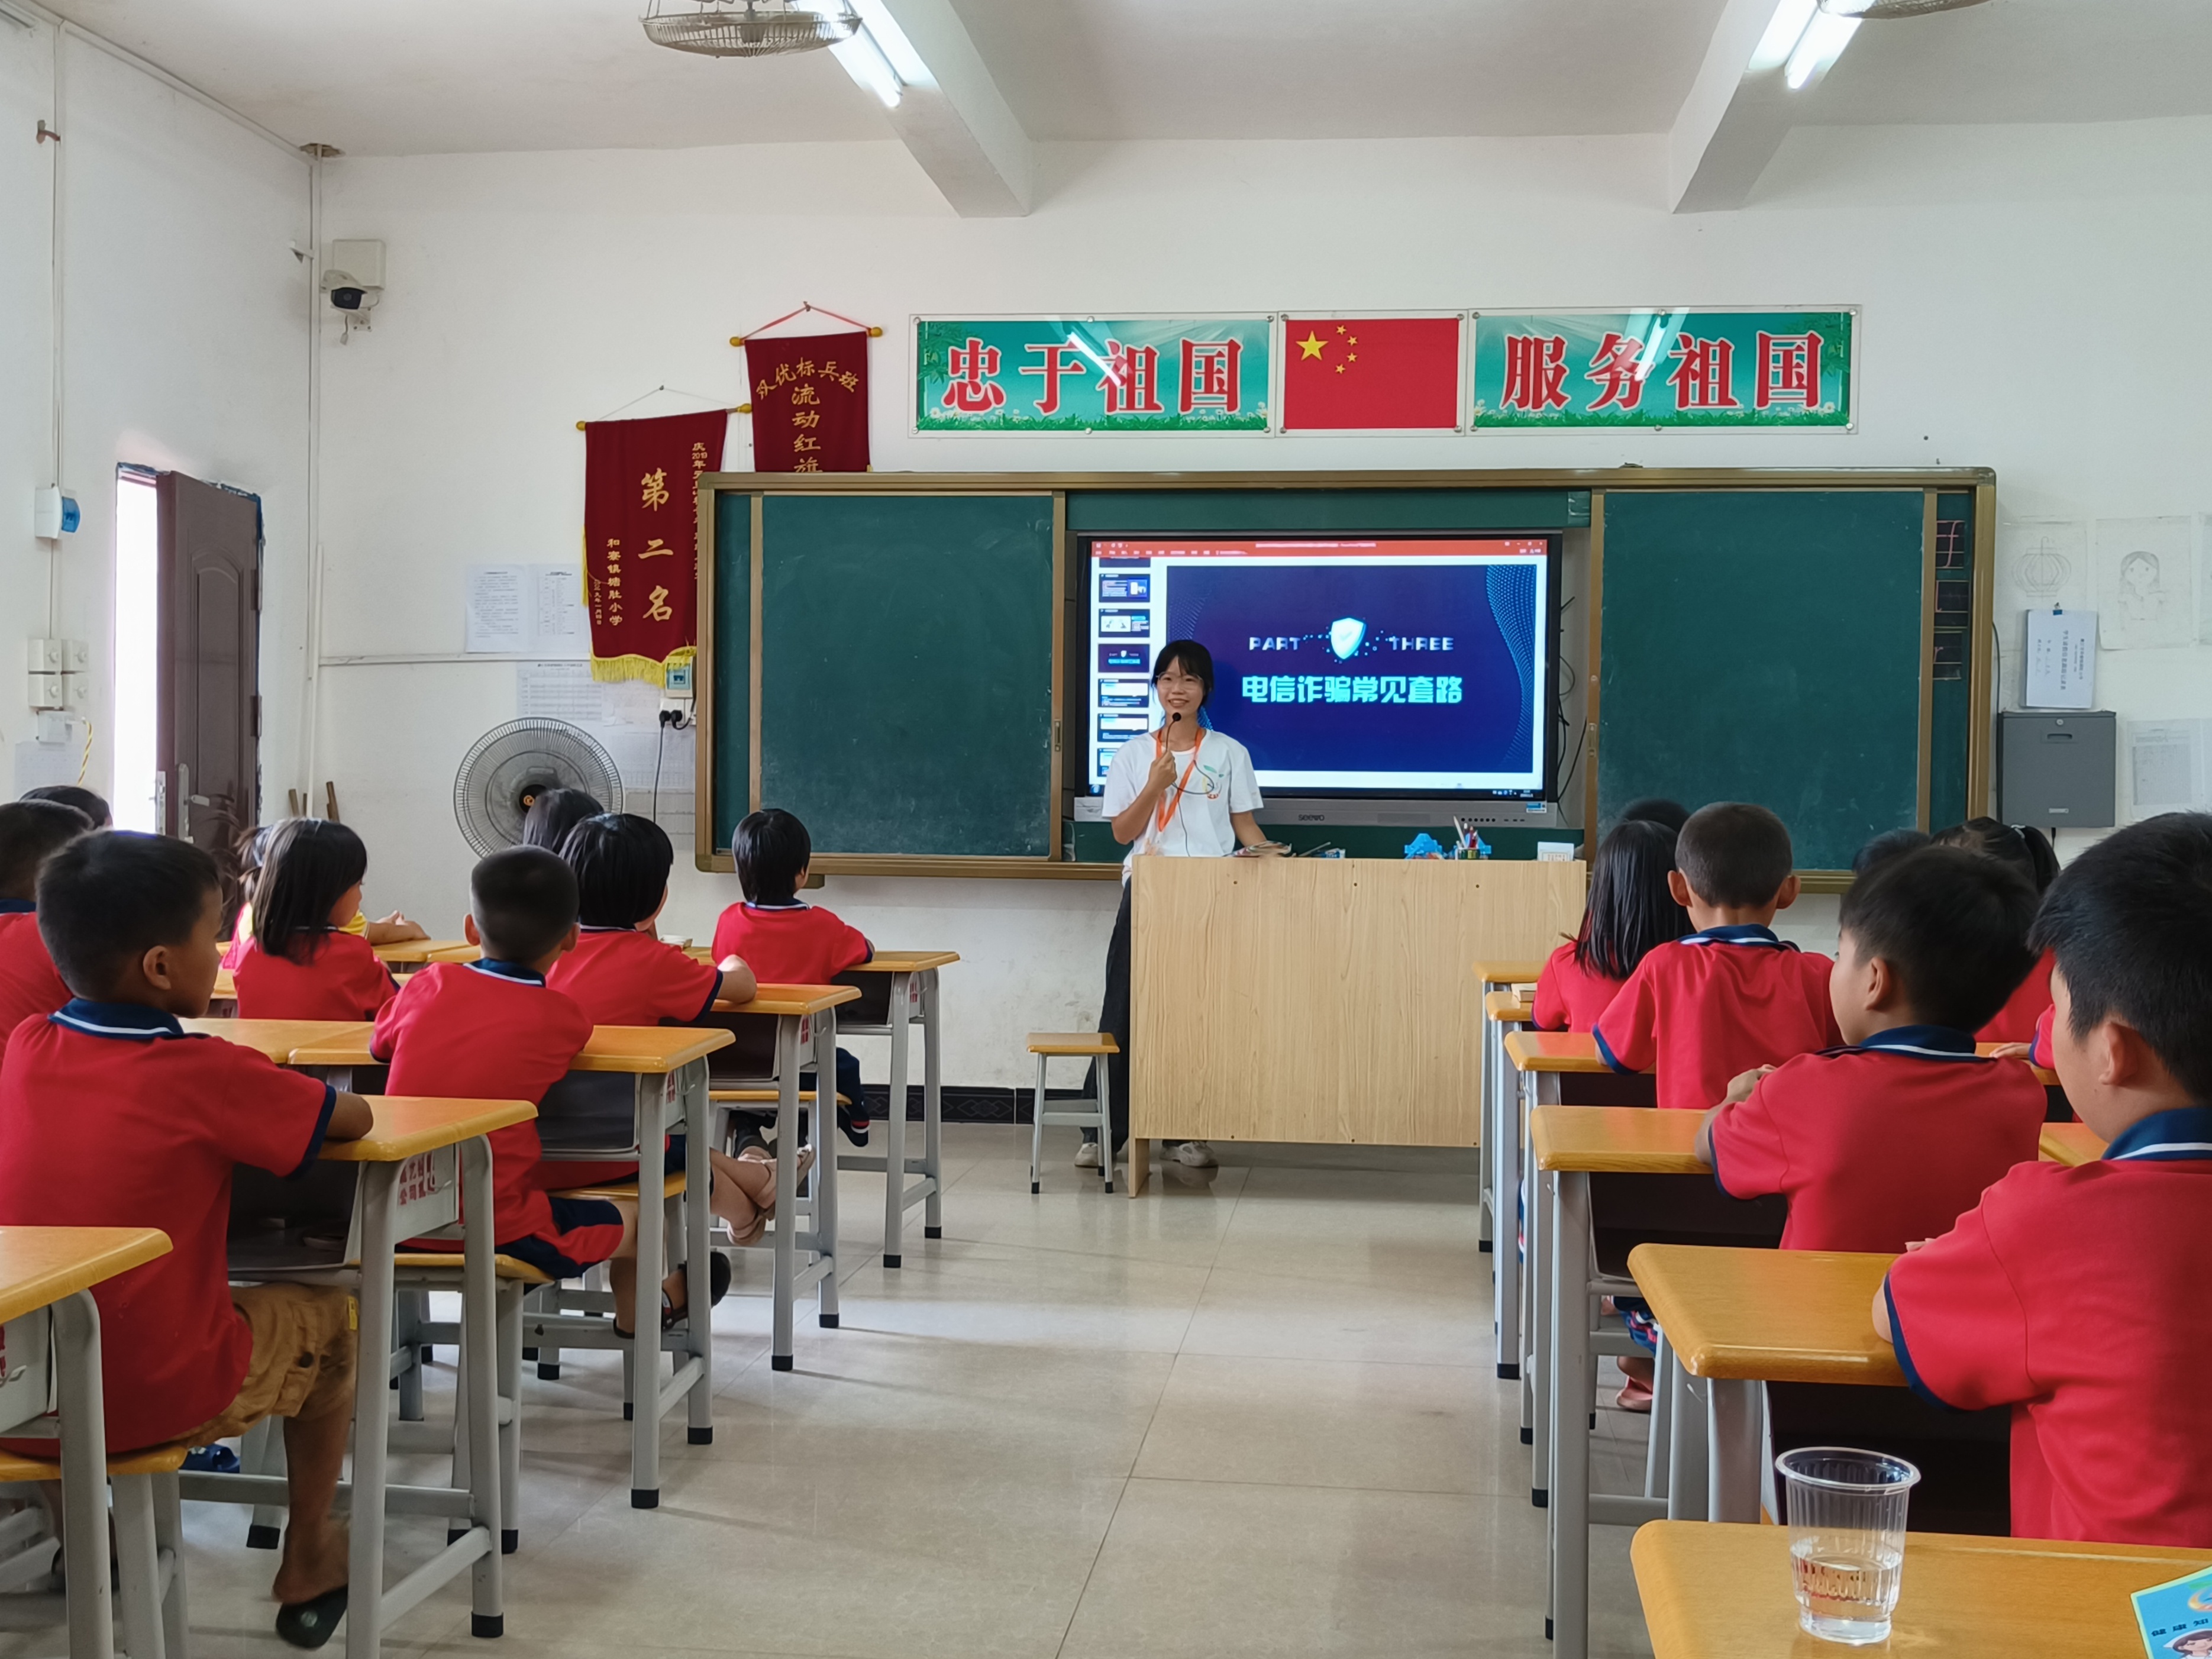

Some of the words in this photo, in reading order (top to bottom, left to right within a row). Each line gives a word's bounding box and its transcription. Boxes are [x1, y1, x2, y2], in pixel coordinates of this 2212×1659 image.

[943, 337, 1244, 415] 忠于祖国
[1499, 330, 1825, 411] 服务祖国
[638, 467, 674, 622] 第二名
[1248, 637, 1301, 651] PART
[1390, 637, 1454, 651] THREE
[1242, 676, 1463, 703] 电信诈骗常见套路
